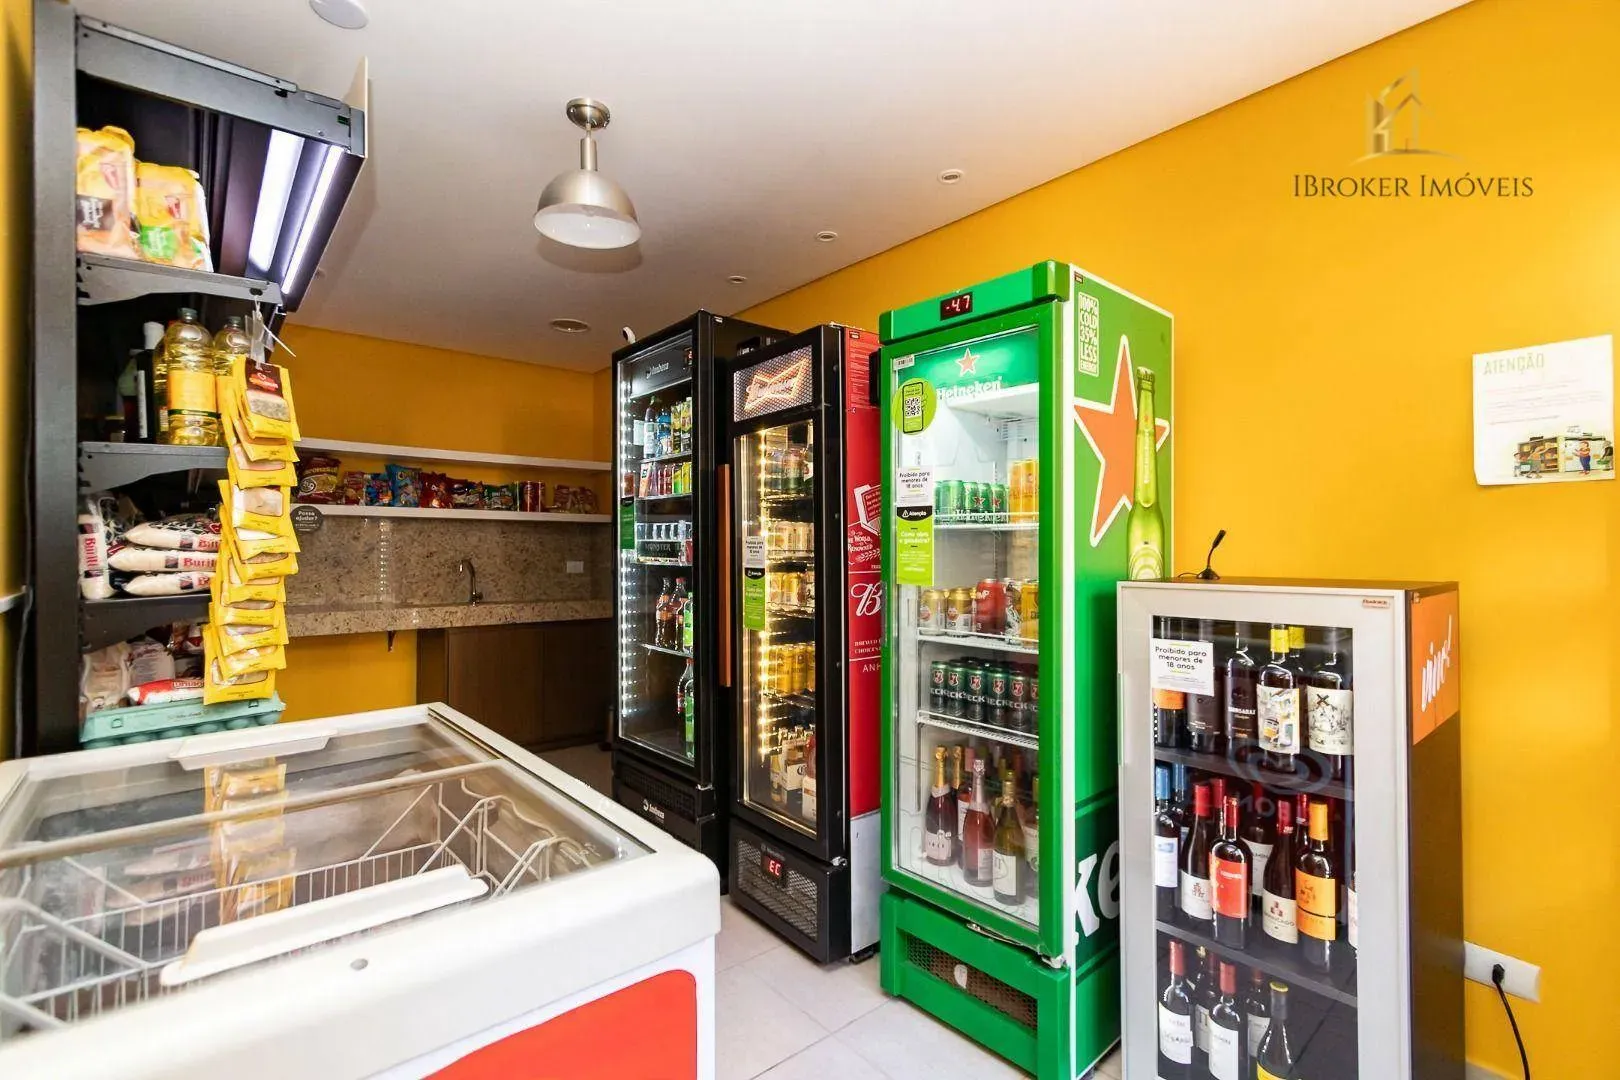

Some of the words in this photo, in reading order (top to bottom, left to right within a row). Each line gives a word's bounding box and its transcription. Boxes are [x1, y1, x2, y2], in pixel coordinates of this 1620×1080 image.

[1079, 310, 1098, 328] COLD
[1079, 325, 1098, 346] 35%
[1079, 341, 1098, 362] LESS
[935, 379, 1001, 400] Heineken
[1155, 646, 1185, 656] Proibido
[1158, 654, 1191, 664] menores
[768, 859, 781, 876] EC
